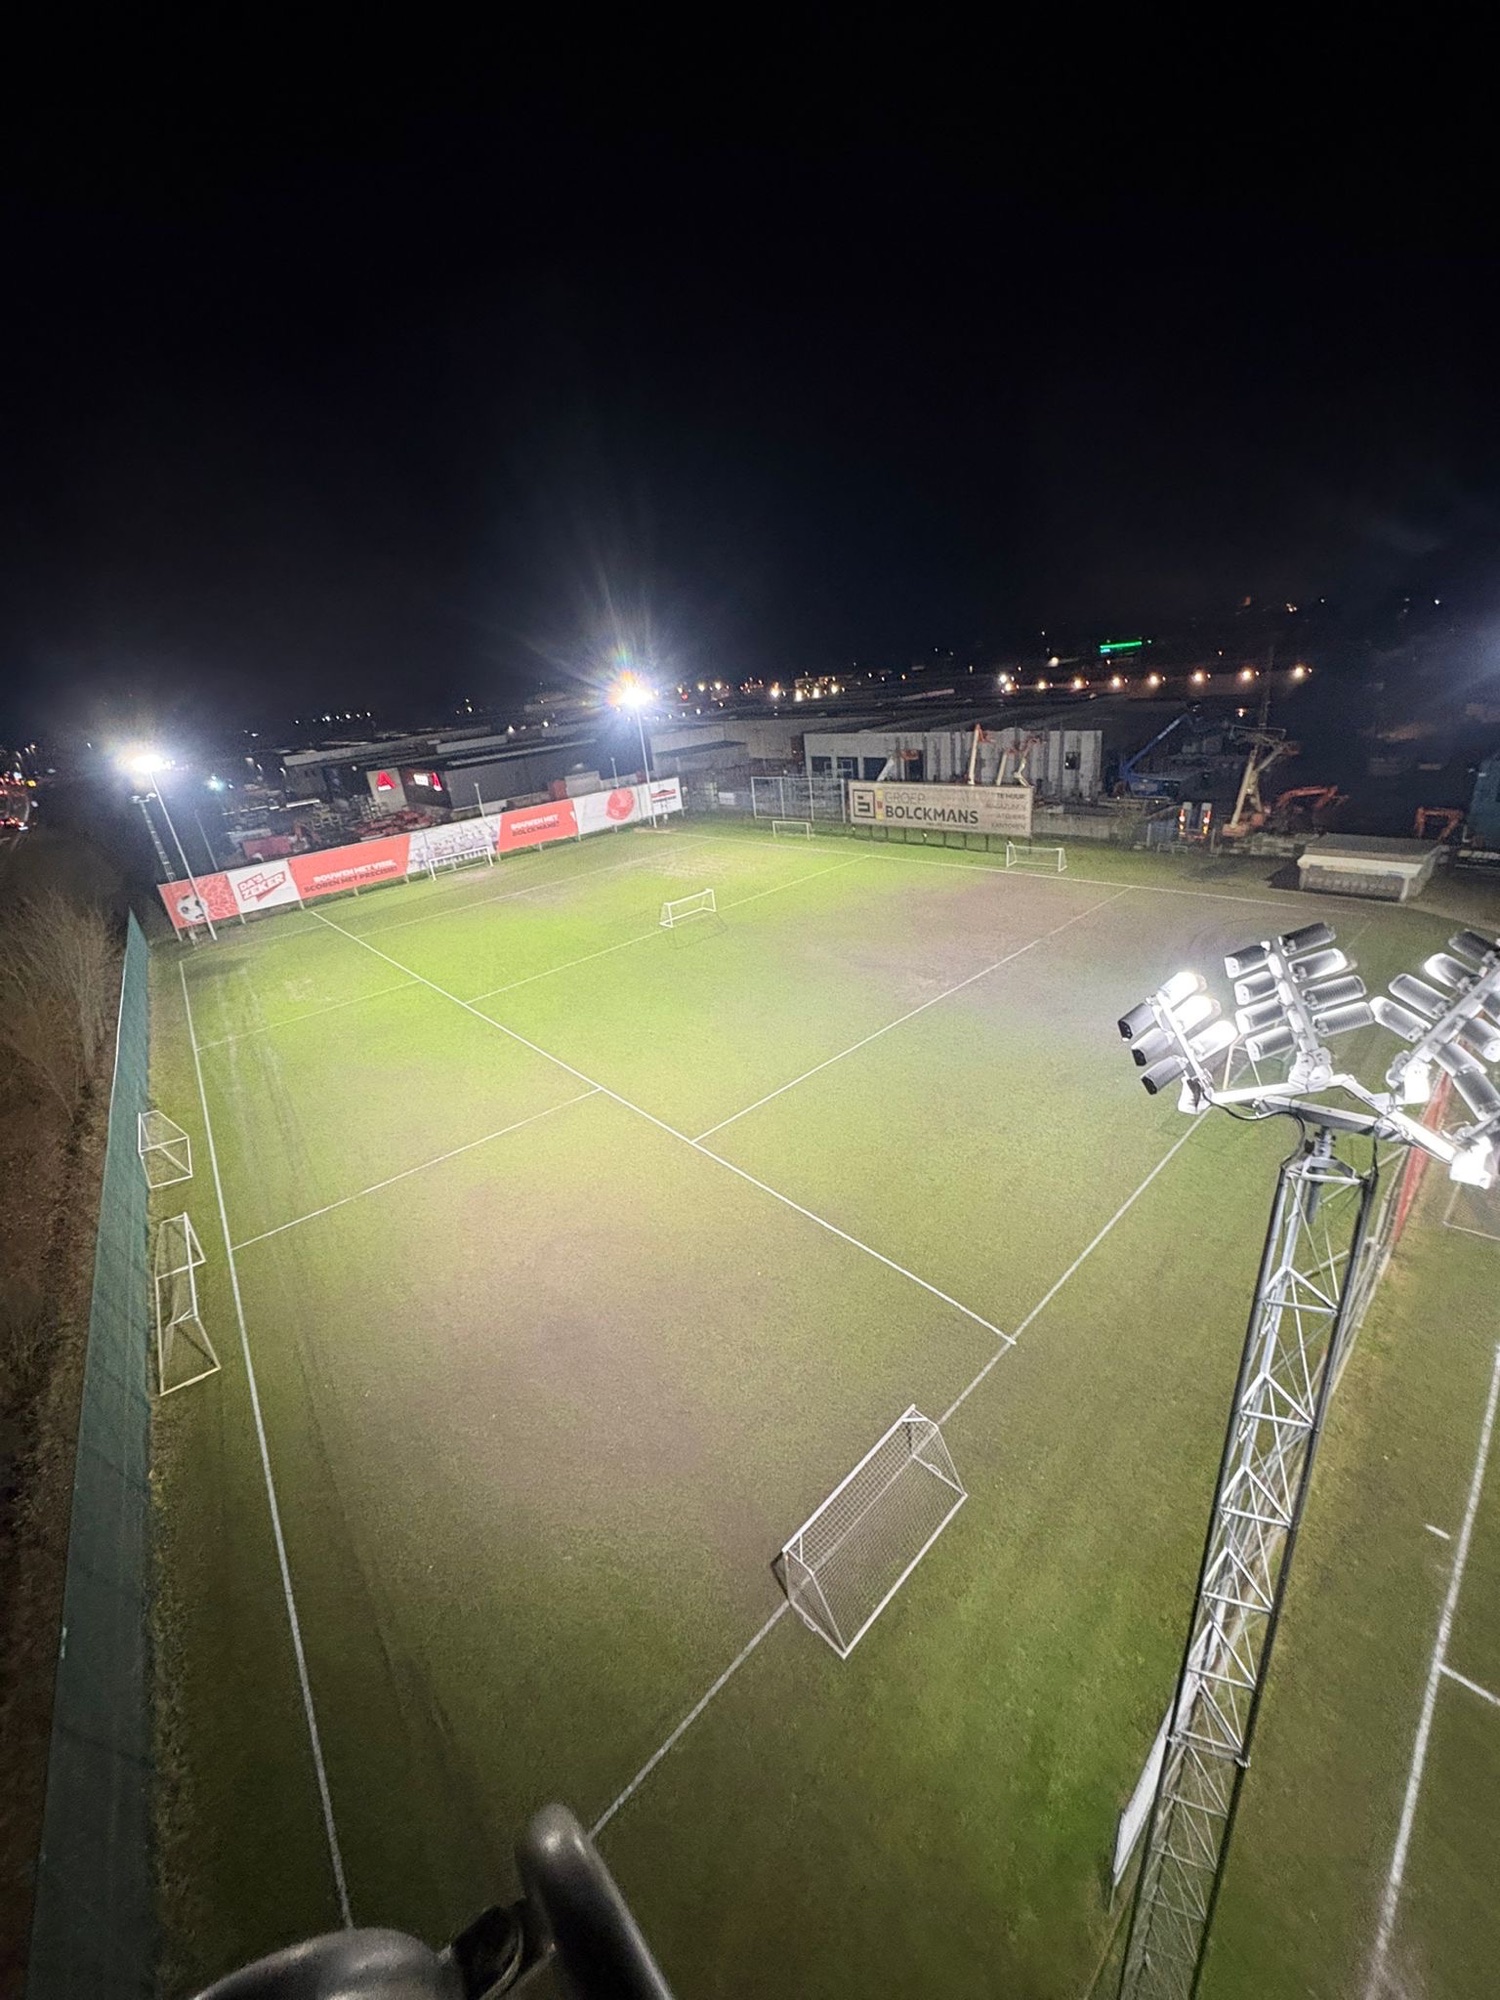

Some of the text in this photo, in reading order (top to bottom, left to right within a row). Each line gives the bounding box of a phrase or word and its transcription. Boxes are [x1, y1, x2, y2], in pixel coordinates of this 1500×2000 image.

[885, 791, 926, 805] GROEP
[885, 806, 979, 824] BOLCKMANS
[313, 868, 354, 883] BOUWEN
[242, 875, 284, 900] ZEKER
[304, 878, 341, 893] SCOREN
[340, 876, 358, 884] MET
